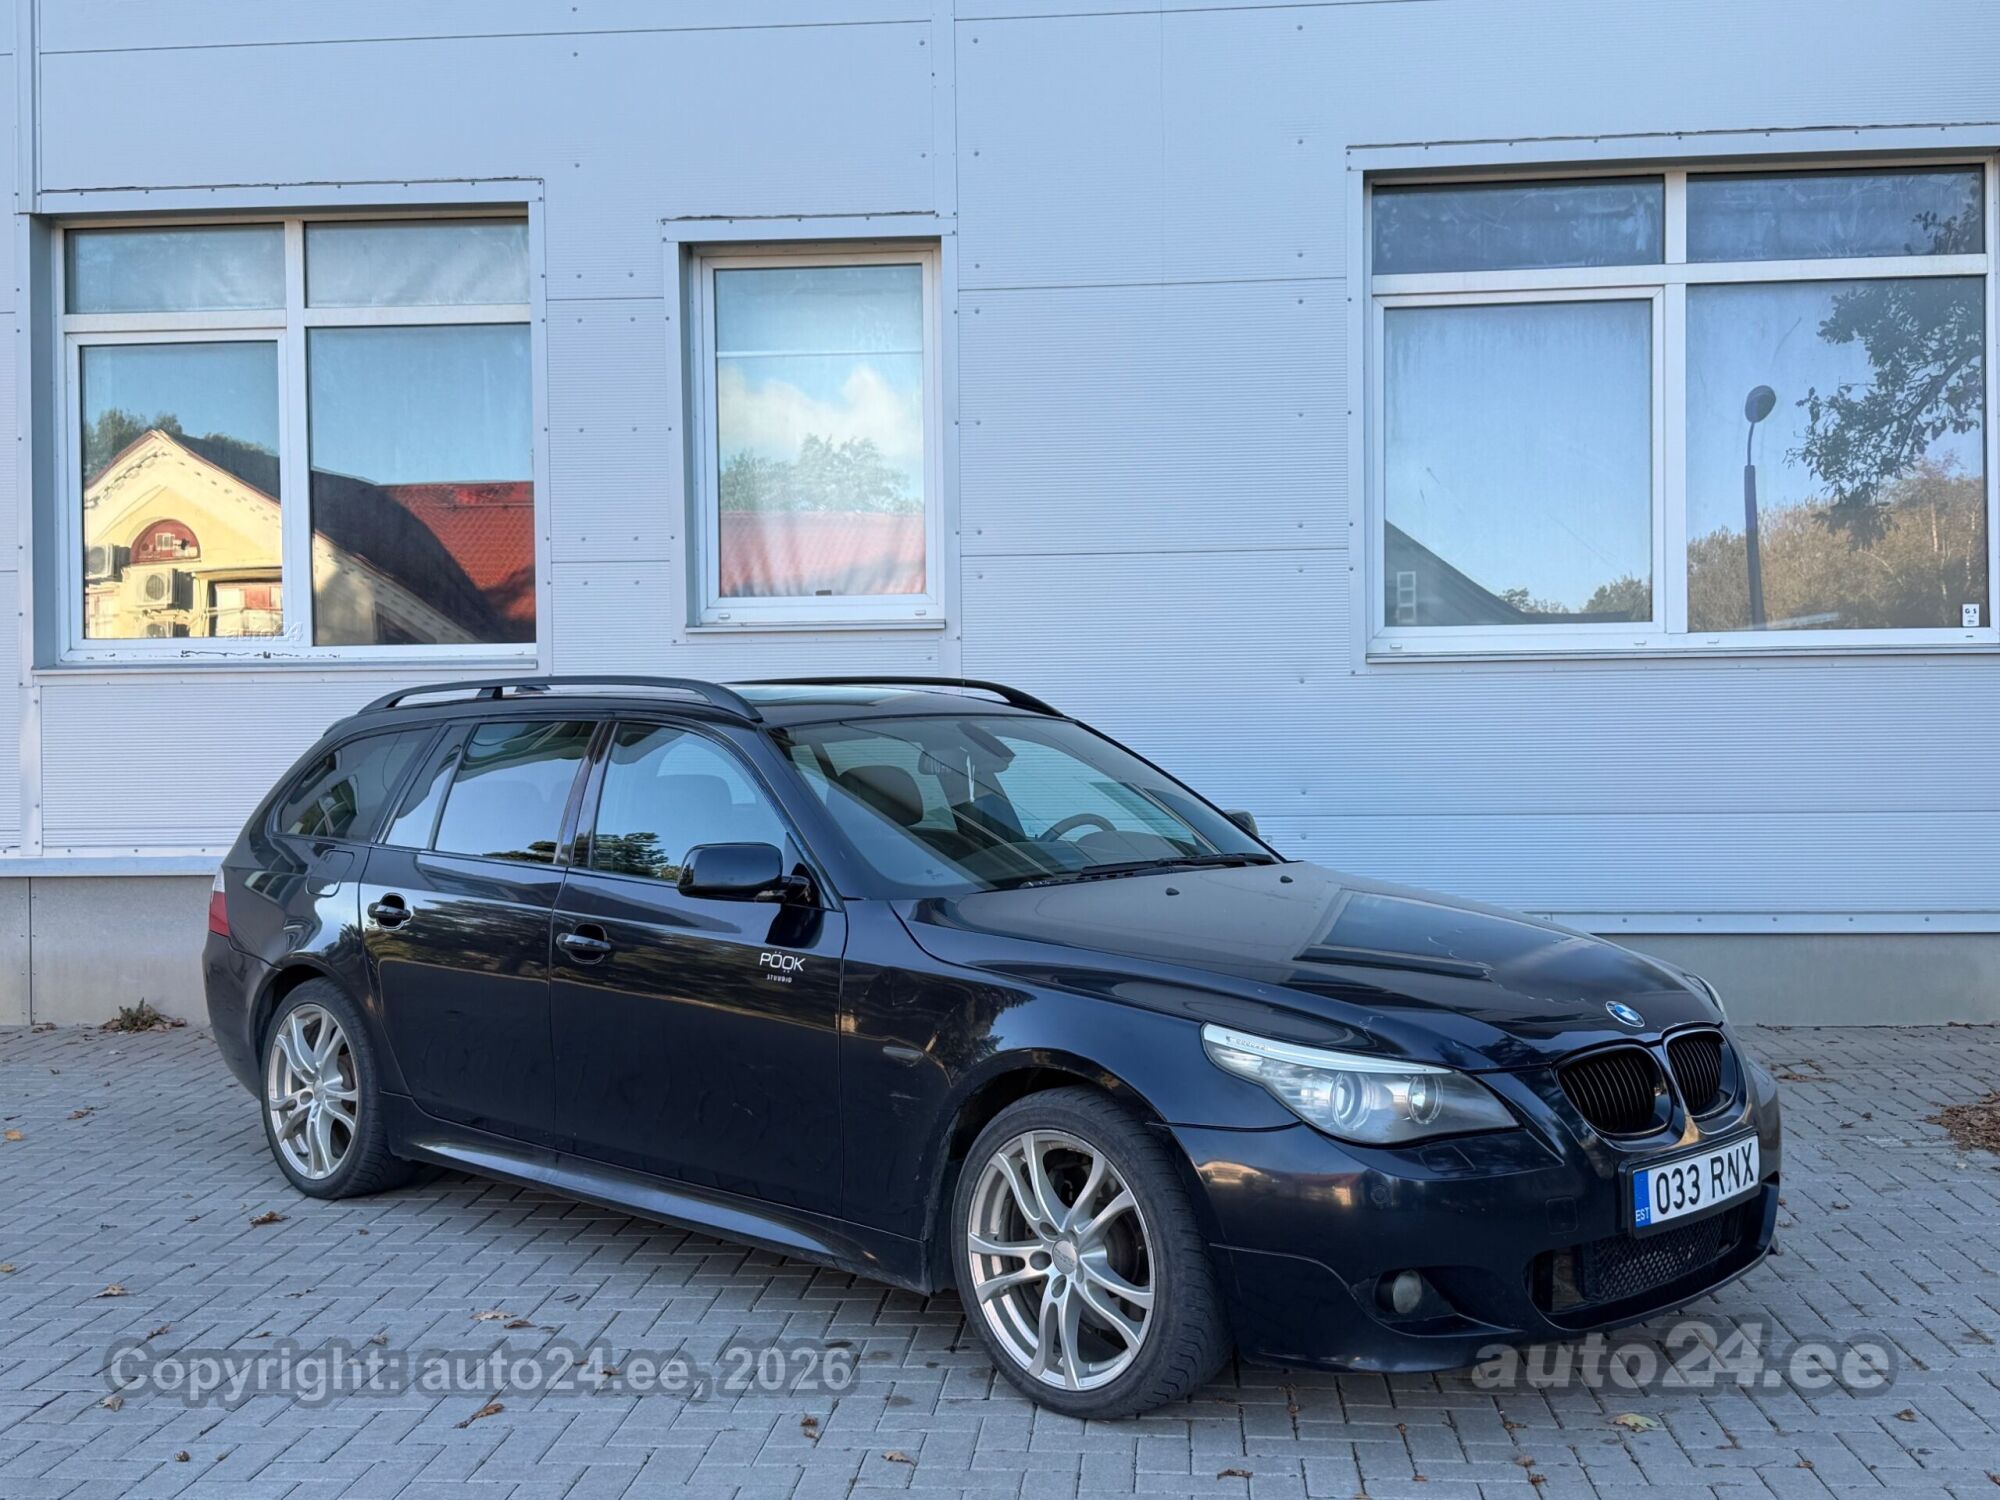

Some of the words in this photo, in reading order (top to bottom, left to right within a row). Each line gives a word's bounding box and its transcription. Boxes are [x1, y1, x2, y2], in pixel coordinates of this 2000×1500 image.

[1656, 1164, 1700, 1215] 033
[1710, 1142, 1754, 1199] RNX
[1635, 1207, 1650, 1222] EST
